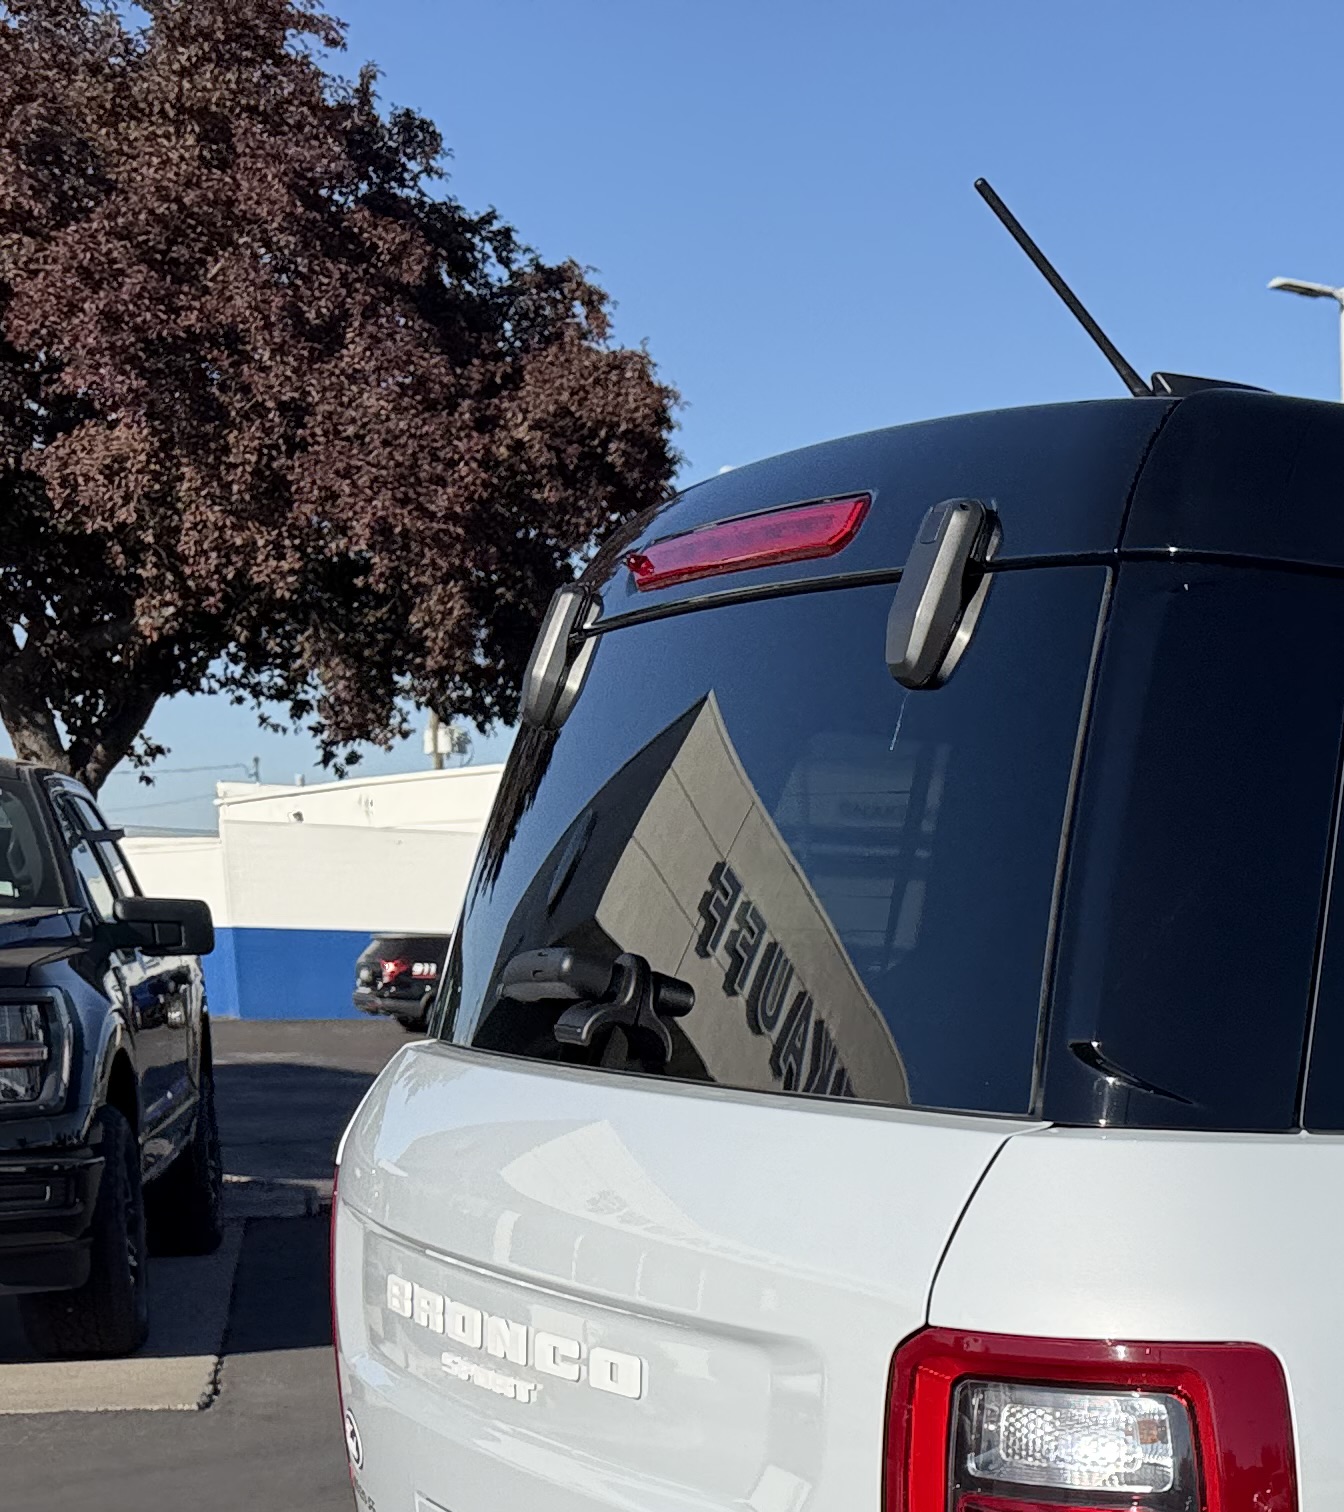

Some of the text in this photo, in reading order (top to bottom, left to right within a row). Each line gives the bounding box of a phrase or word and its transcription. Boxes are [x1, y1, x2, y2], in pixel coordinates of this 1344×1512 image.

[412, 962, 437, 976] 911
[386, 1272, 649, 1401] BRONCO
[440, 1351, 542, 1404] SPORT
